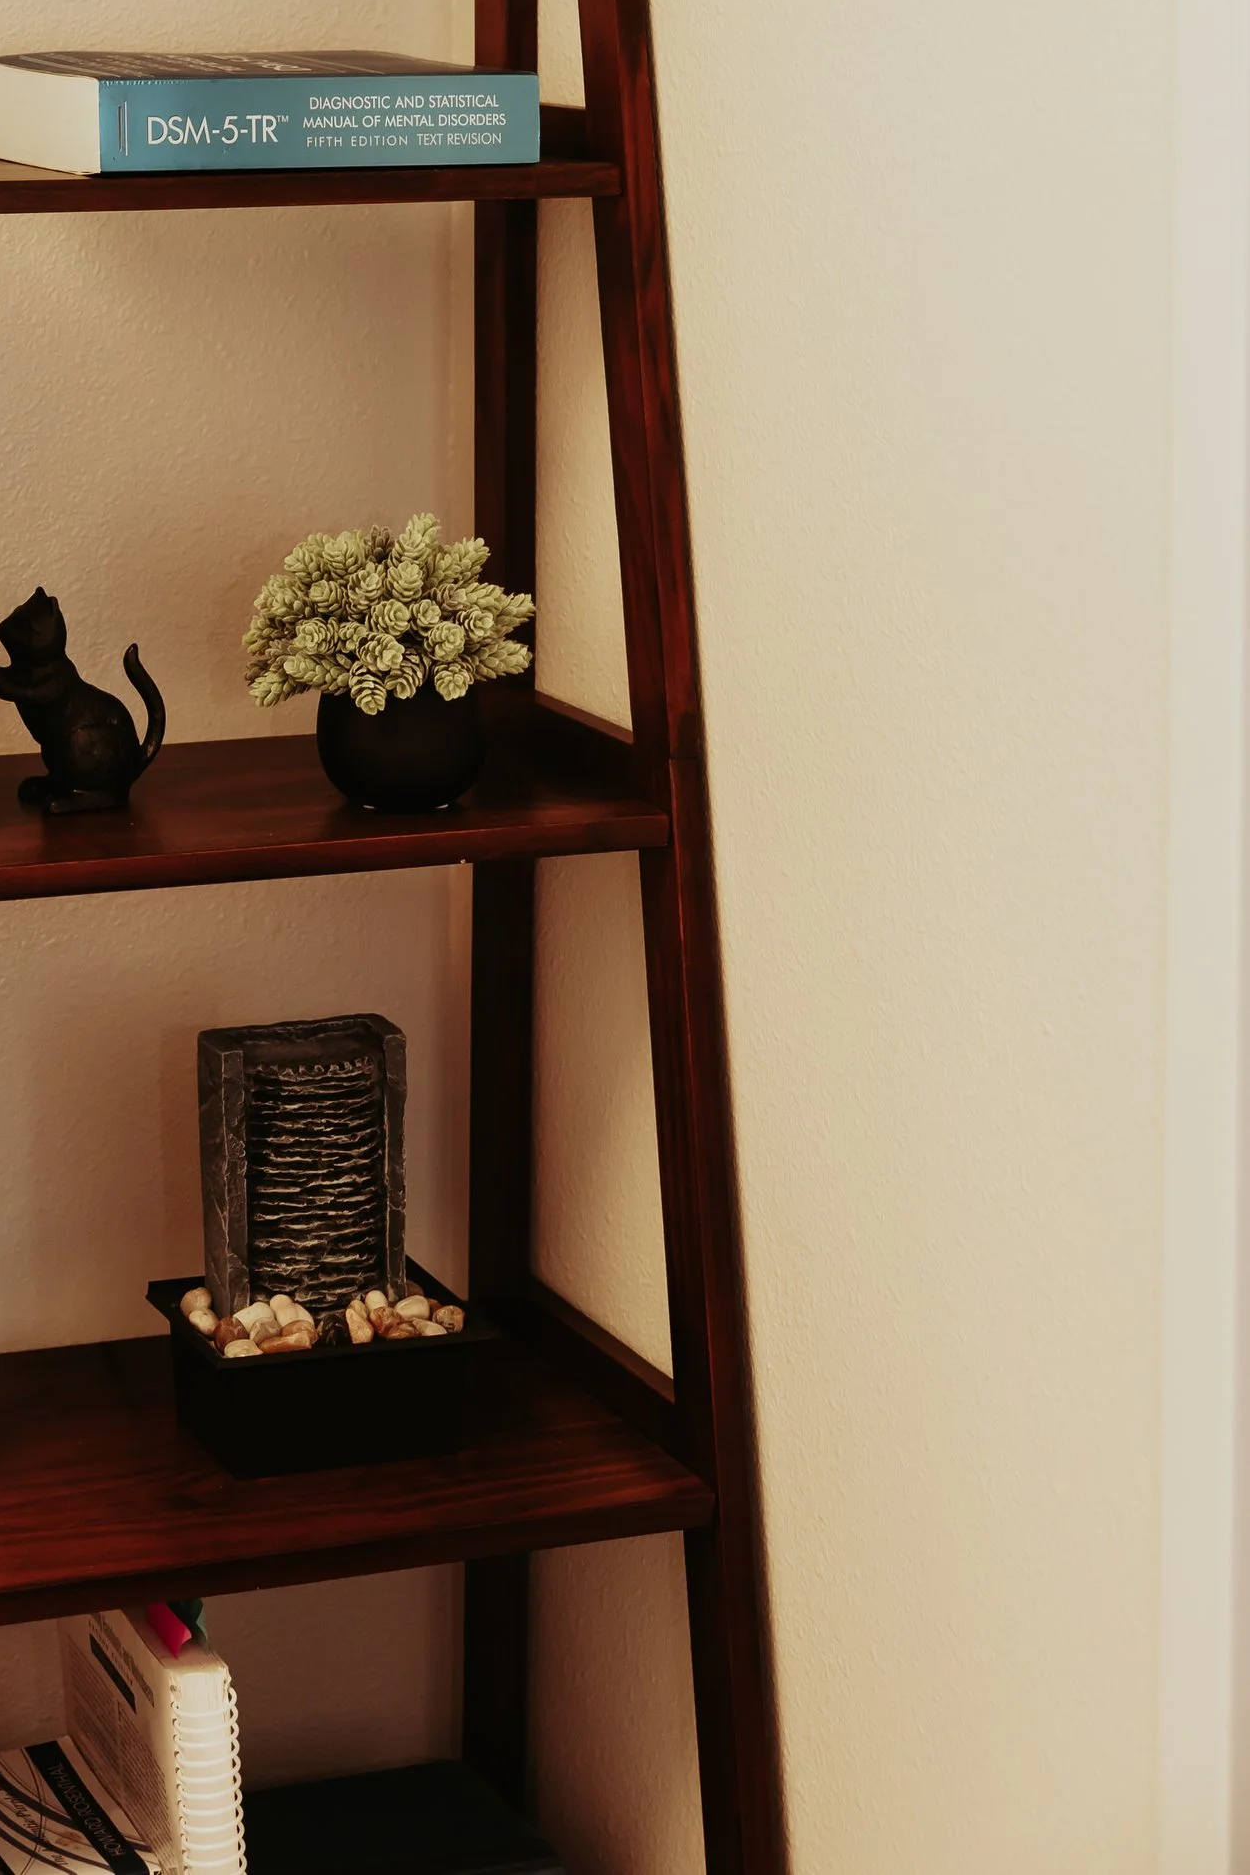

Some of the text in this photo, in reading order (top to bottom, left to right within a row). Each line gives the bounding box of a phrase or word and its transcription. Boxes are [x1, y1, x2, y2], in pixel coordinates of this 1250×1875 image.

[309, 94, 499, 110] DIAGNOSTIC AND STATISTICAL
[302, 113, 506, 129] MANUAL OF MENTAL DISORDERS
[306, 132, 502, 147] FIFTH EDITION TEXT REVISION
[48, 1763, 126, 1856] HOWARD ROSENTHAL
